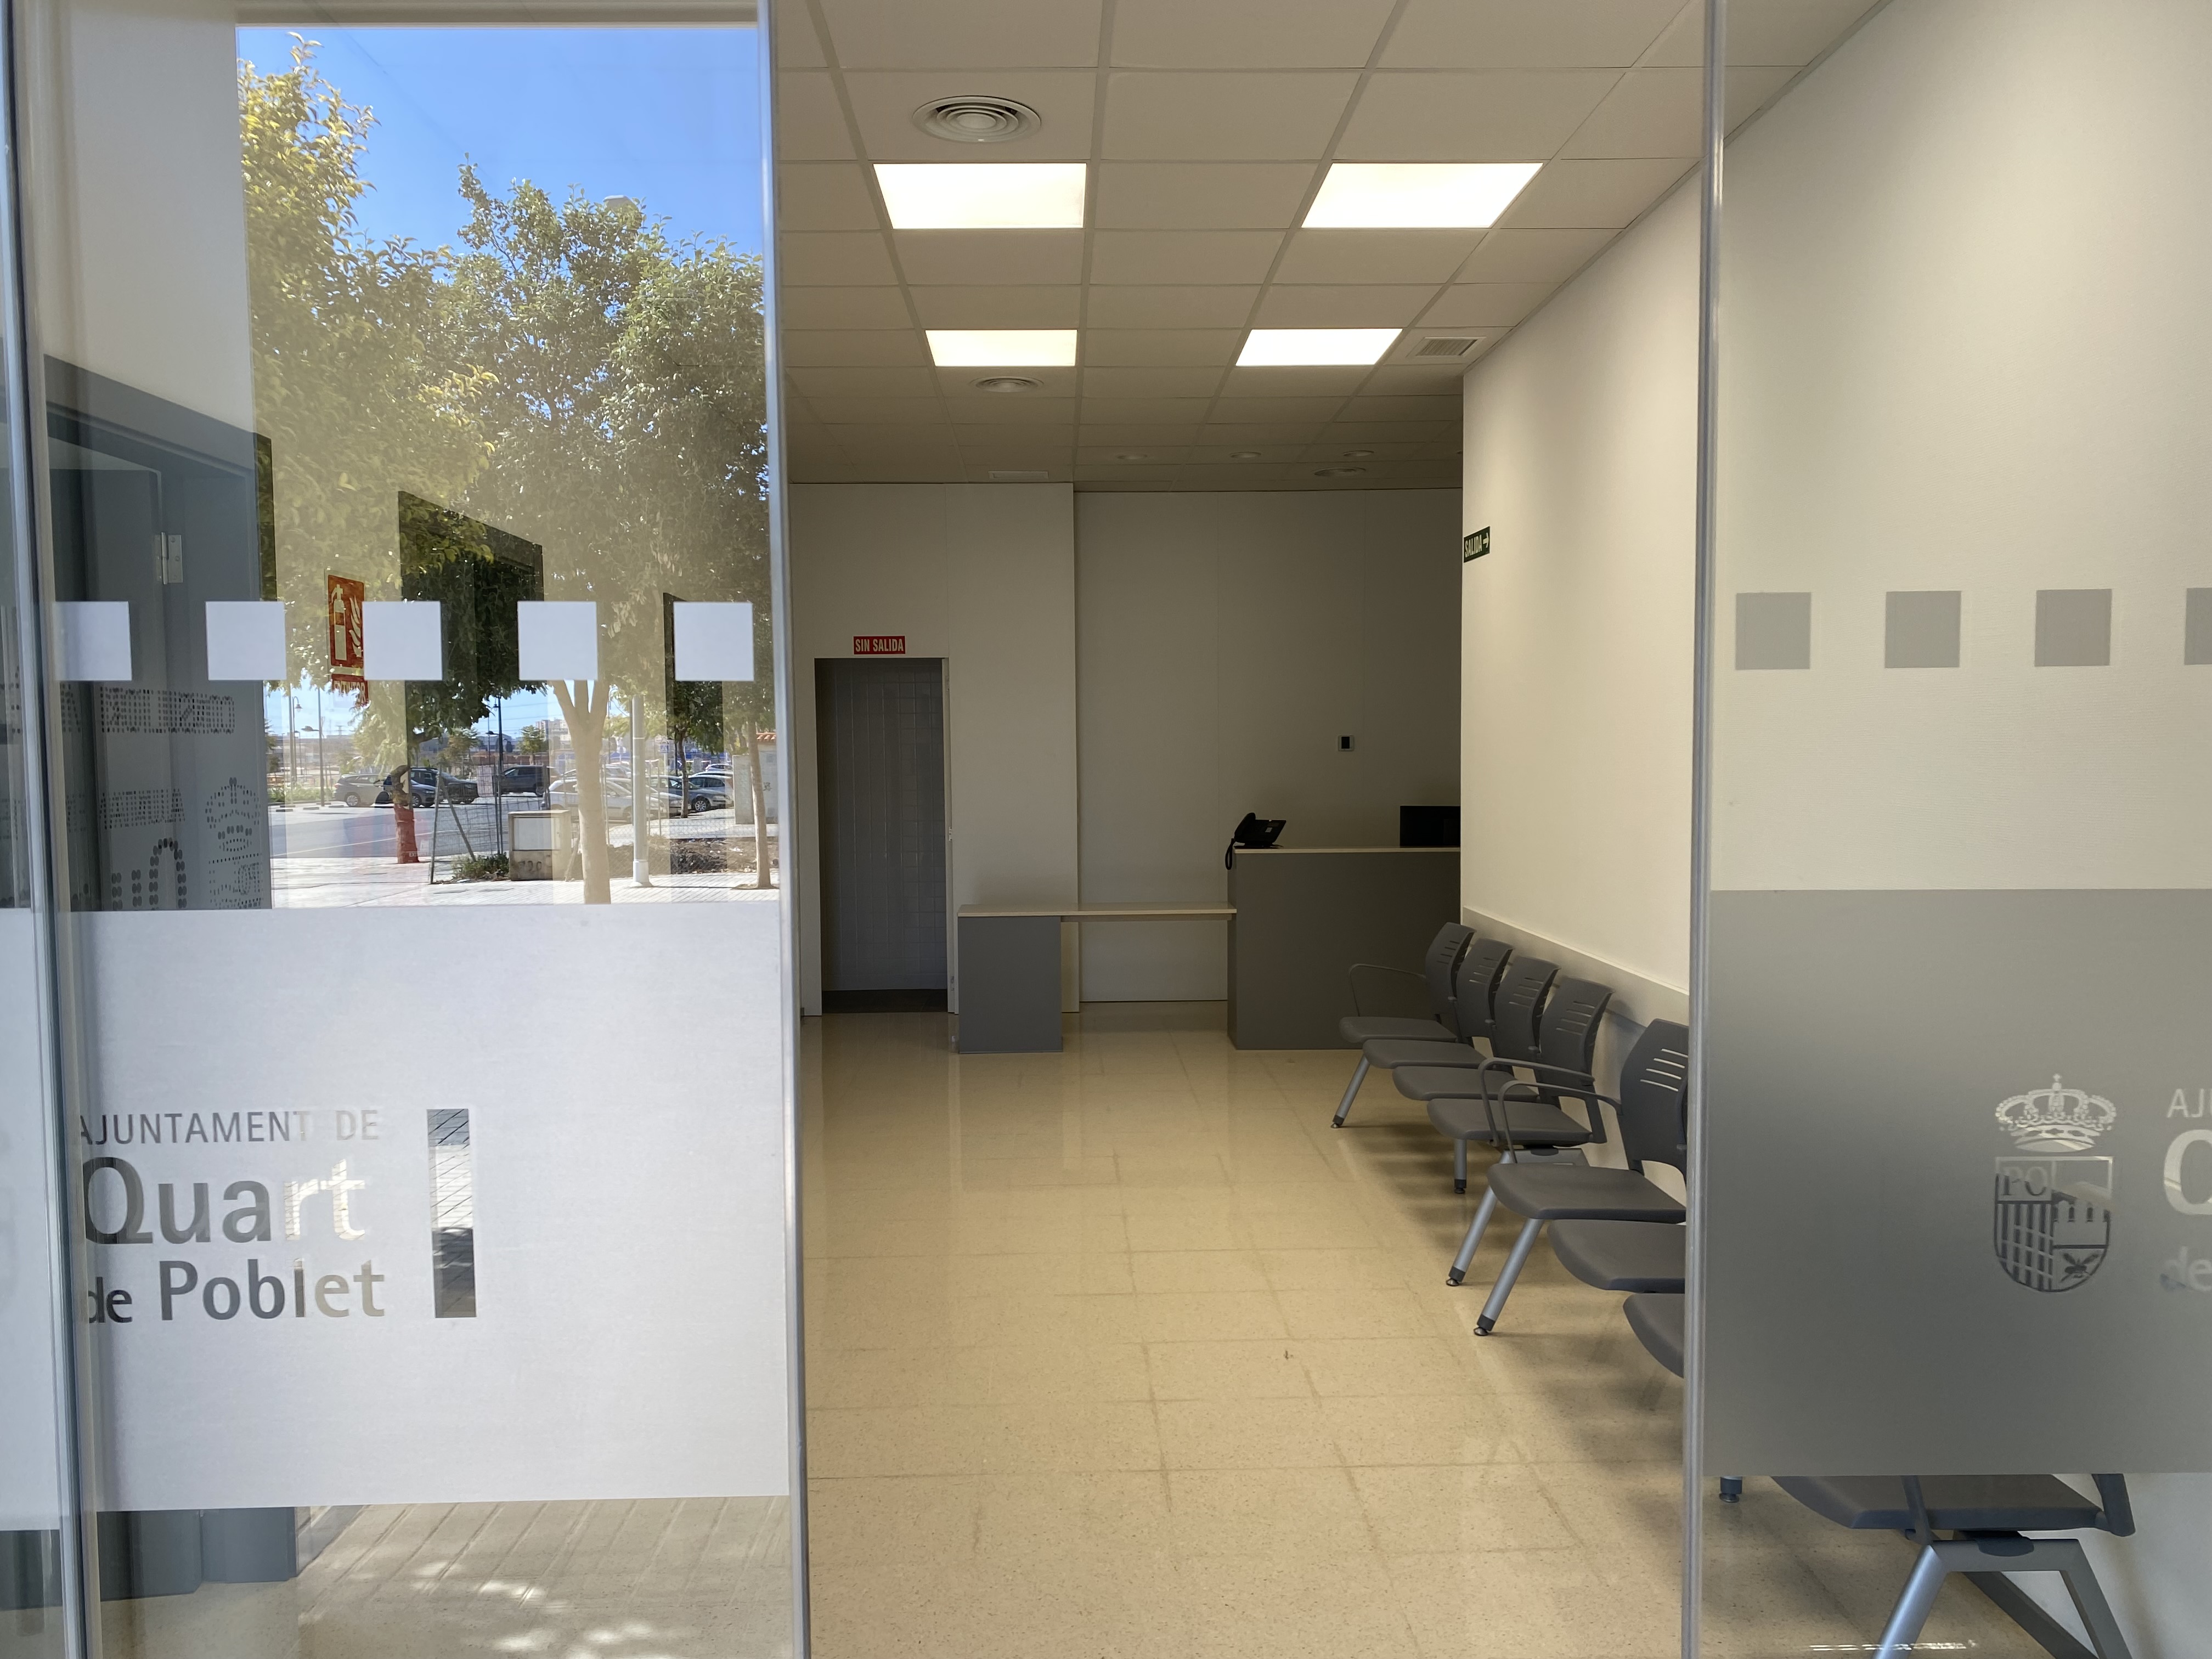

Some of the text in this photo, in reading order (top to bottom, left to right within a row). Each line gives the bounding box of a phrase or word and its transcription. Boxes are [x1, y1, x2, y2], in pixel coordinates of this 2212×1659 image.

[1465, 534, 1482, 557] SALIDA
[855, 638, 904, 652] SIN SALIDA
[80, 1109, 380, 1146] AJUNTAMENT DE
[81, 1156, 366, 1245] Quart
[88, 1259, 386, 1324] de Poblet
